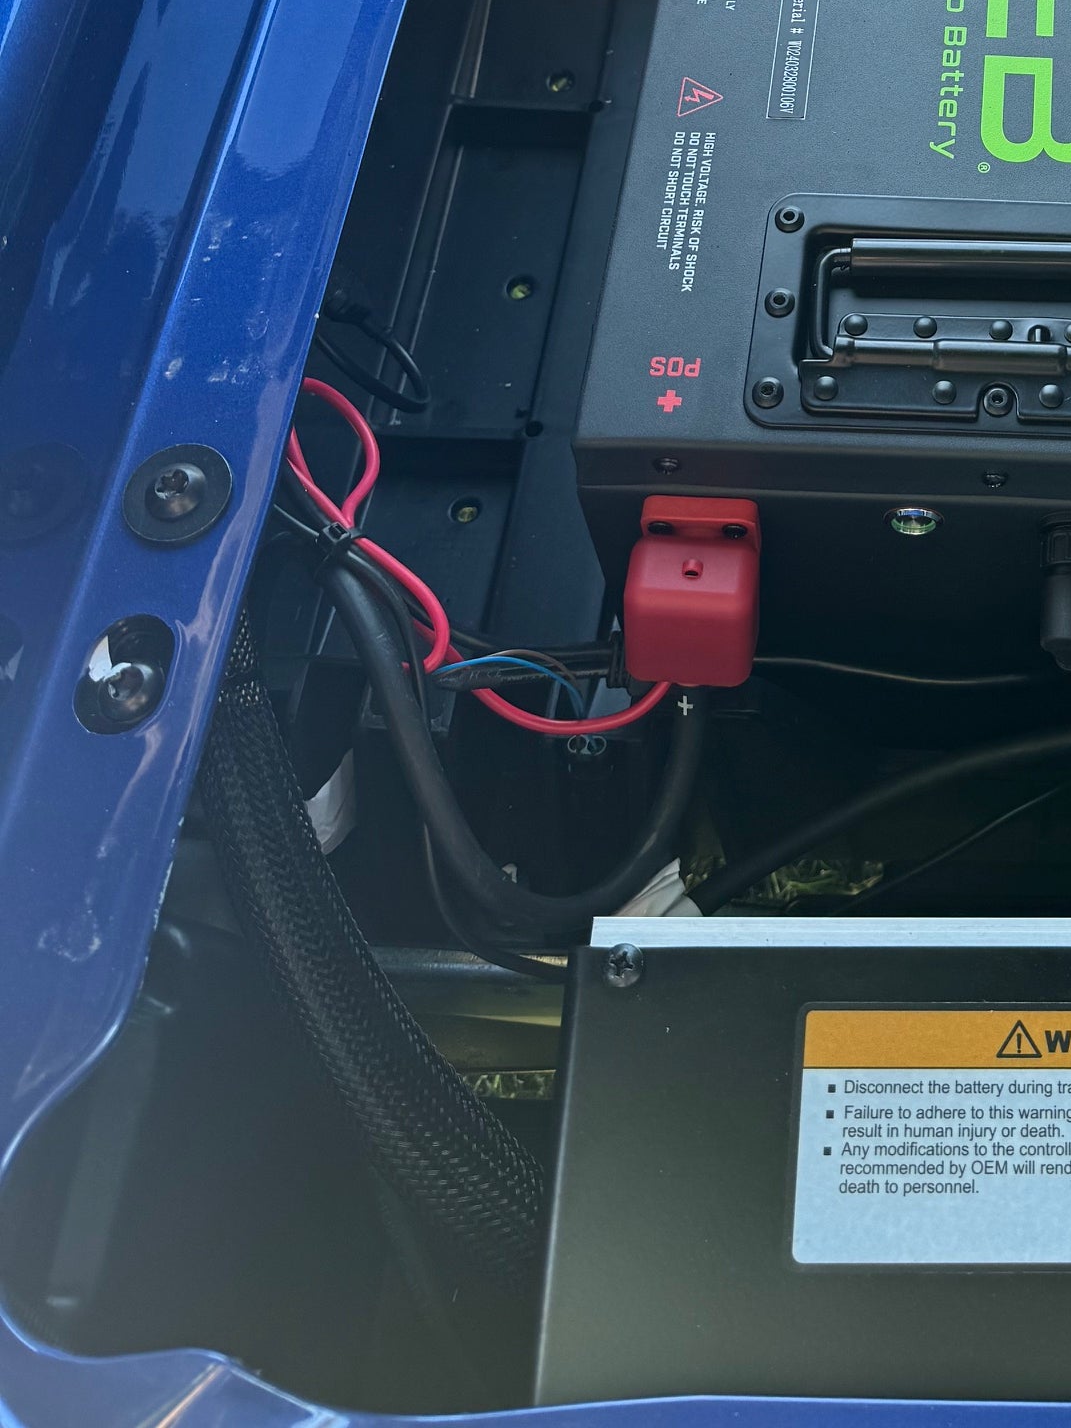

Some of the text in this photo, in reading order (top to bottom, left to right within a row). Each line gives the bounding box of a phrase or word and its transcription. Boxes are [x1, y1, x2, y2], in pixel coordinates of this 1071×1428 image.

[930, 26, 967, 159] Battery
[657, 132, 685, 249] DO NOT SHORT CIRCUIT
[669, 132, 701, 270] DO NOT TOUCH TERMINALS
[681, 133, 716, 291] HIGH VOLTAGE. RISK OF SHOCK
[649, 356, 702, 377] POS
[843, 1079, 924, 1095] Disconnect
[927, 1079, 951, 1095] the
[954, 1079, 1005, 1098] battery
[1007, 1079, 1053, 1098] during
[844, 1104, 894, 1120] Failure
[897, 1105, 912, 1120] to
[915, 1104, 967, 1120] adhere
[970, 1105, 985, 1120] to
[988, 1104, 1015, 1120] this
[842, 1122, 1065, 1142] result in human injury or death.
[840, 1141, 870, 1160] Any
[874, 1141, 970, 1157] modifications
[972, 1142, 988, 1157] to
[991, 1141, 1015, 1157] the
[839, 1159, 945, 1176] recommended
[949, 1159, 967, 1179] by
[970, 1159, 1008, 1175] OEM
[1012, 1159, 1036, 1175] will
[838, 1178, 980, 1198] death to personnel.
